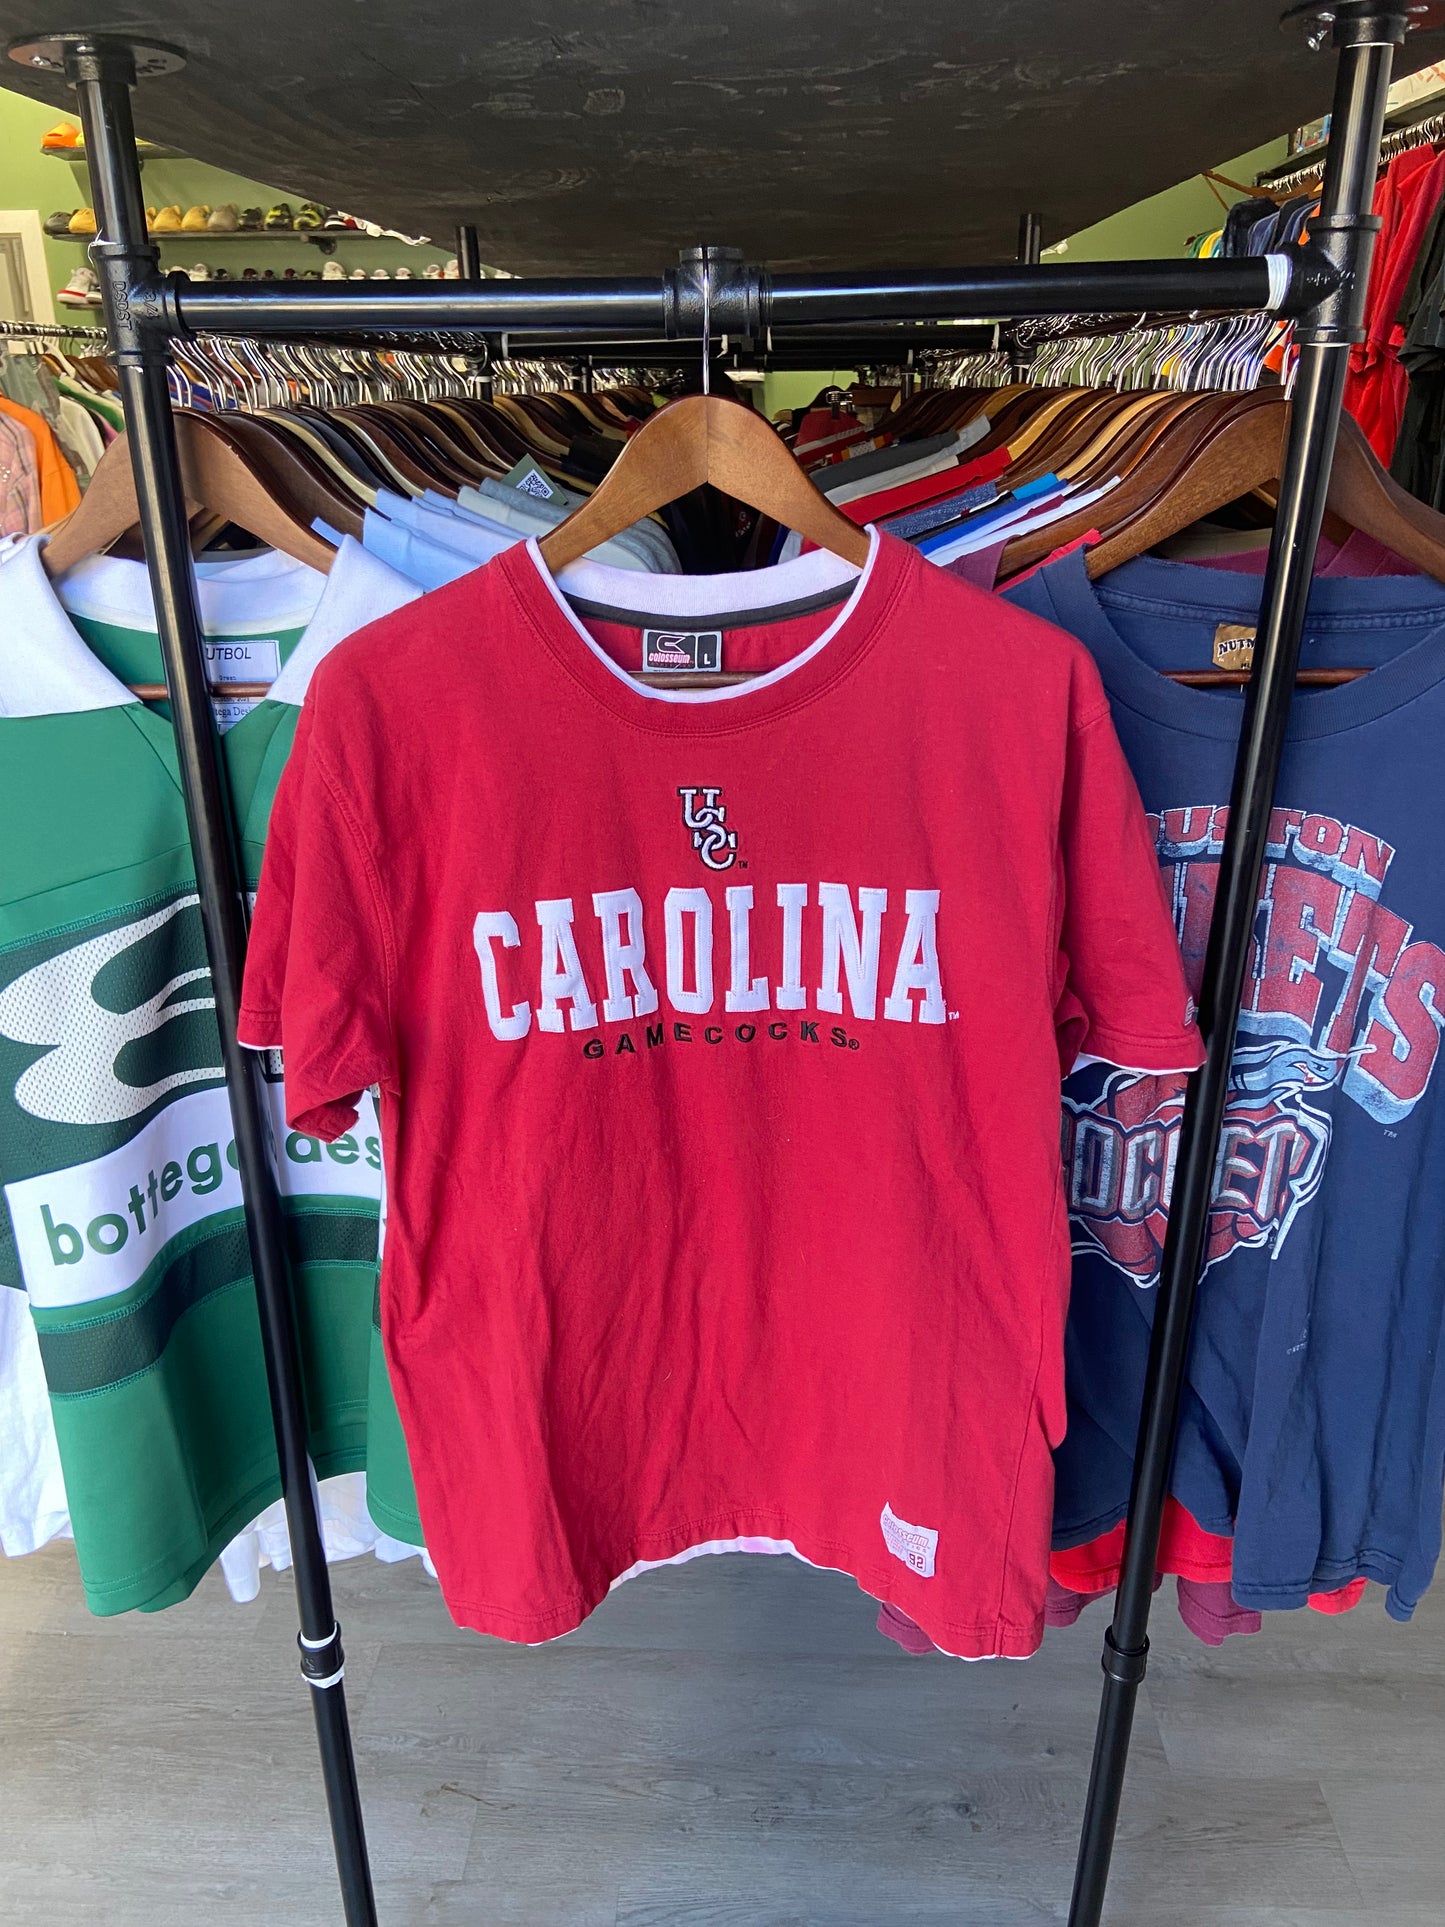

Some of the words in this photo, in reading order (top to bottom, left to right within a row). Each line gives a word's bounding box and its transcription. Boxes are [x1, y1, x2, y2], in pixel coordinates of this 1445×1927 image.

[206, 647, 252, 660] UTBOL
[1217, 637, 1256, 657] NUTM
[648, 652, 690, 664] colosseum
[703, 653, 711, 665] L
[677, 785, 738, 872] USC
[473, 881, 946, 1041] CAROLINA
[909, 1553, 923, 1569] 92
